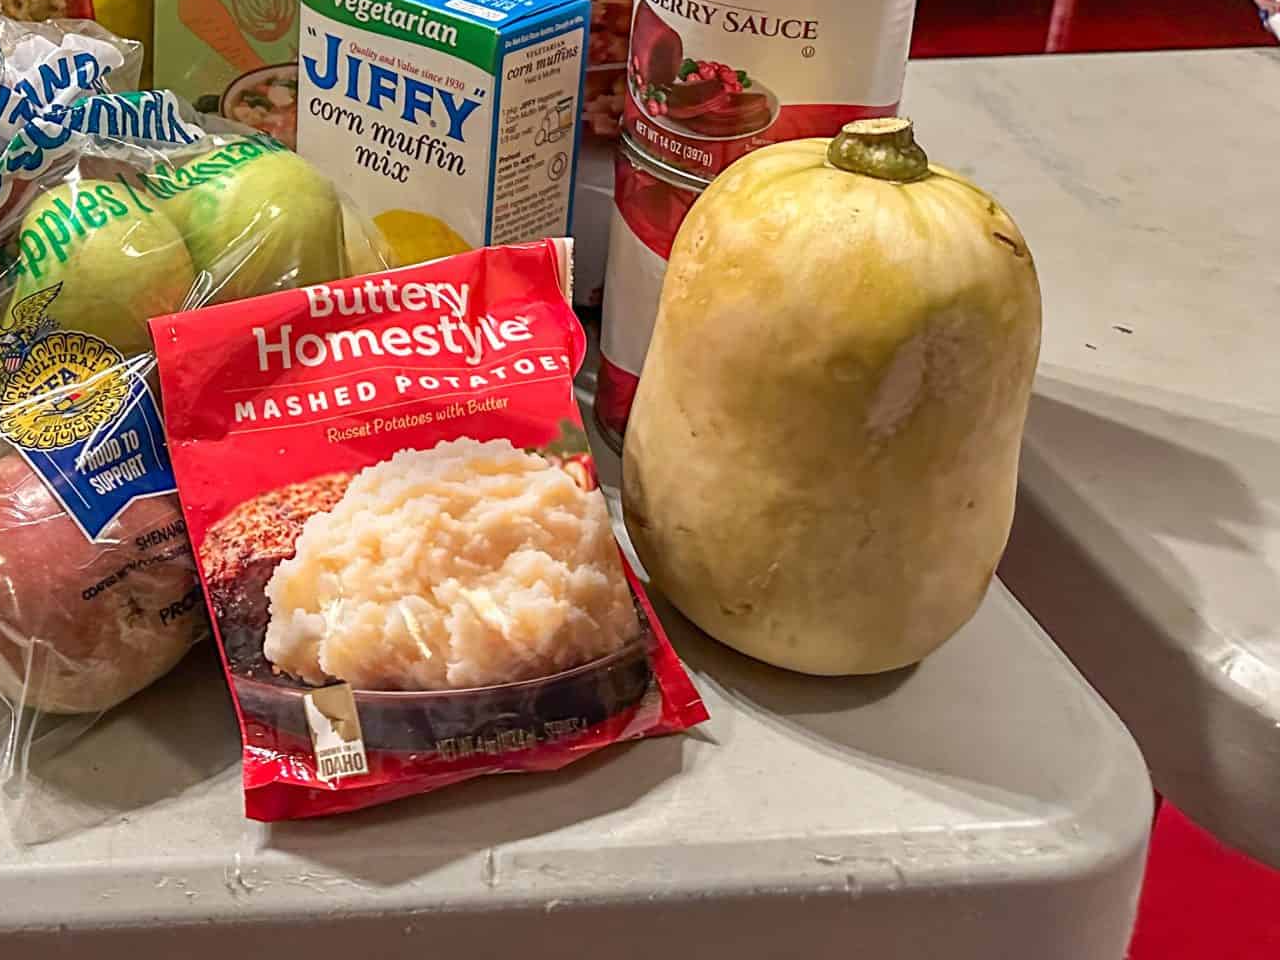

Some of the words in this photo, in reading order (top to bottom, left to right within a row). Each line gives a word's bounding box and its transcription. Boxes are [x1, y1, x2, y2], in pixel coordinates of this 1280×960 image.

[722, 11, 818, 40] SAUCE
[350, 42, 378, 61] Quality
[380, 54, 396, 66] and
[397, 57, 419, 74] Value
[421, 69, 443, 83] since
[445, 75, 465, 91] 1930
[507, 62, 533, 80] corn
[536, 45, 578, 70] muffins
[310, 97, 365, 135] corn
[371, 119, 466, 176] muffin
[647, 129, 658, 143] WT
[659, 135, 669, 149] 14
[670, 141, 682, 154] OZ
[683, 144, 713, 167] (397g)
[355, 145, 410, 183] mix
[305, 278, 471, 323] Buttery
[252, 314, 533, 373] Homestyle
[18, 353, 97, 399] RICULTURAL
[235, 382, 378, 424] MASHED
[326, 423, 373, 443] Russet
[372, 411, 434, 435] Potatoes
[436, 403, 467, 421] with
[468, 396, 511, 417] Butter
[74, 438, 121, 475] PROUD
[120, 430, 140, 453] TO
[89, 453, 147, 495] SUPPORT
[320, 752, 364, 777] IDAHO
